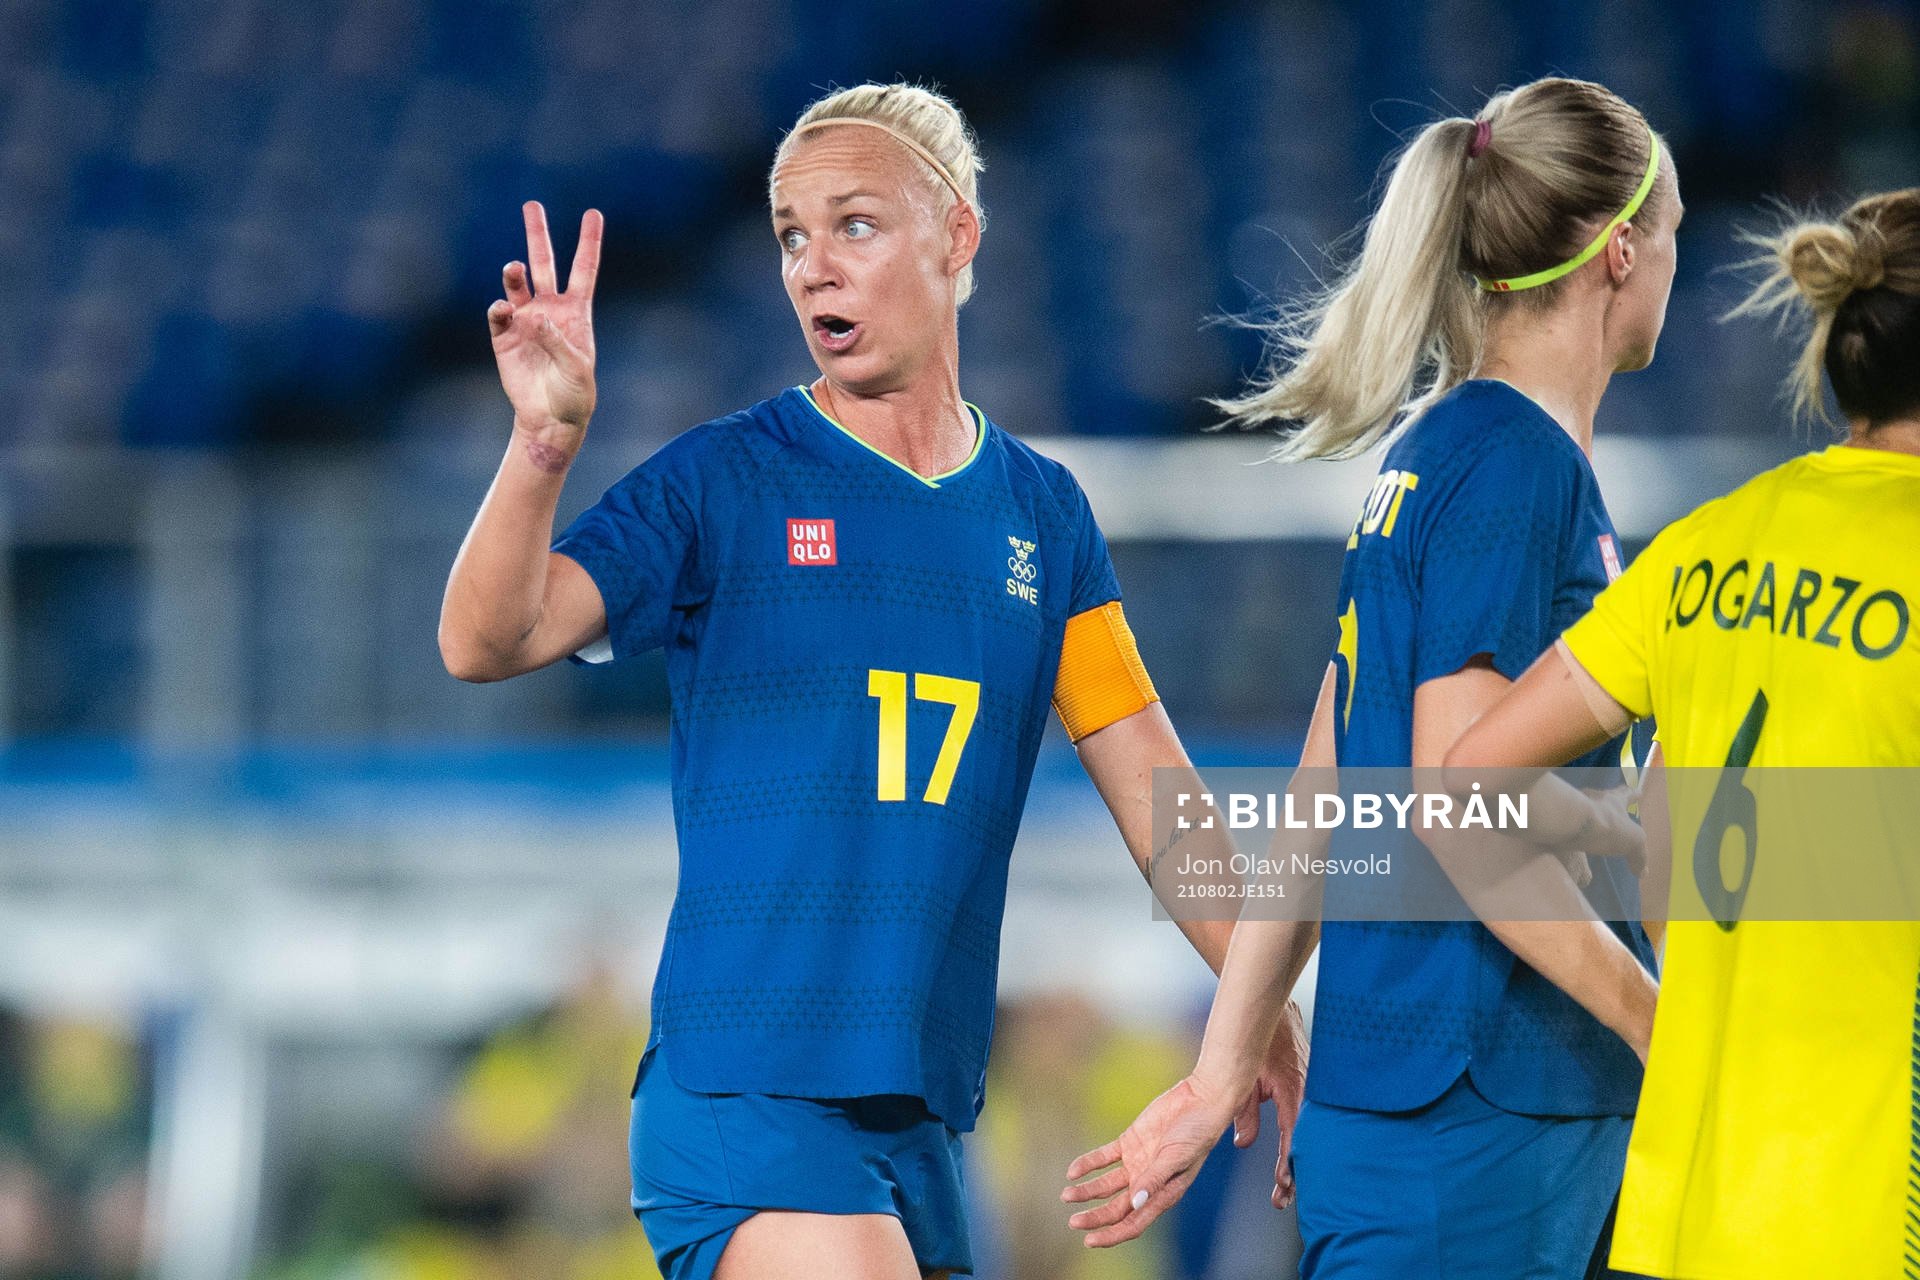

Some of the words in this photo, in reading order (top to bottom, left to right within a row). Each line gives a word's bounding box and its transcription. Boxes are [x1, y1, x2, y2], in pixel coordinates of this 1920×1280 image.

[792, 524, 827, 541] UNI
[793, 542, 831, 562] QLO
[1006, 579, 1038, 605] SWE
[868, 669, 981, 806] 17
[1693, 687, 1769, 933] 6
